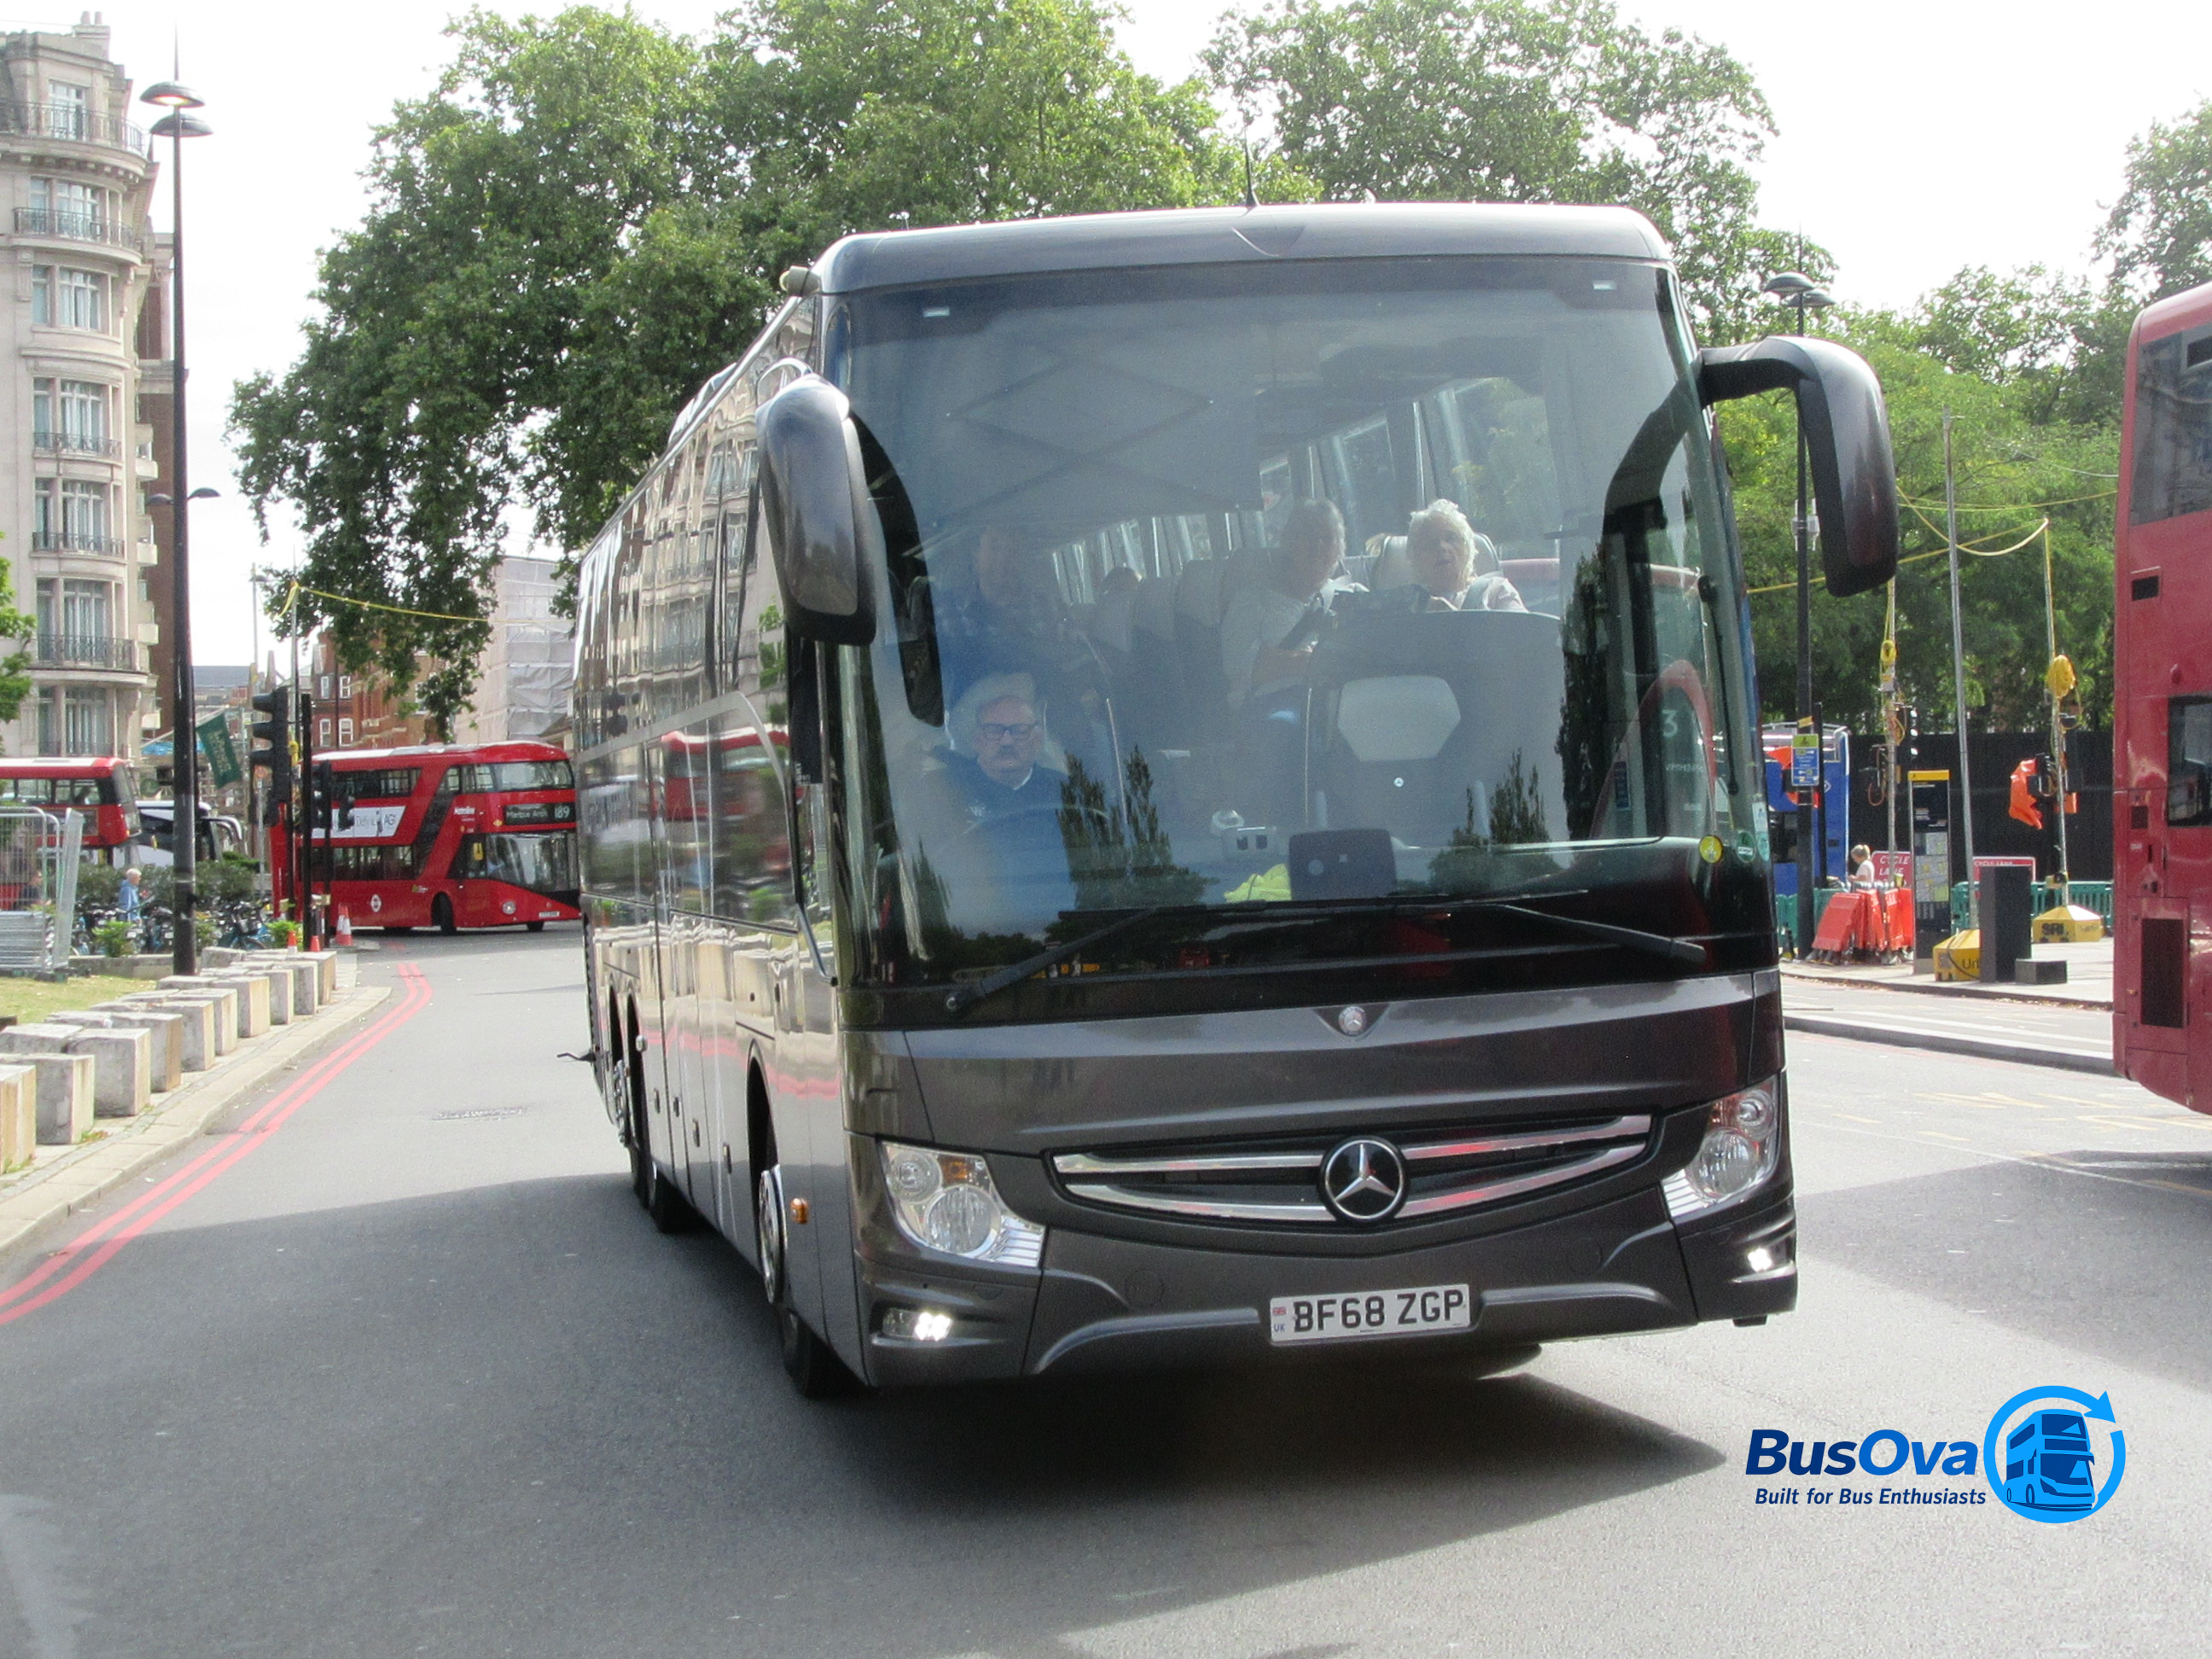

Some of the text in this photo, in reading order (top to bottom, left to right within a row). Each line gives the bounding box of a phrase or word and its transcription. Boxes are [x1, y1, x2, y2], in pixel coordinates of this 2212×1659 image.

[556, 805, 571, 819] 189
[1293, 1289, 1464, 1333] BF68 ZGP
